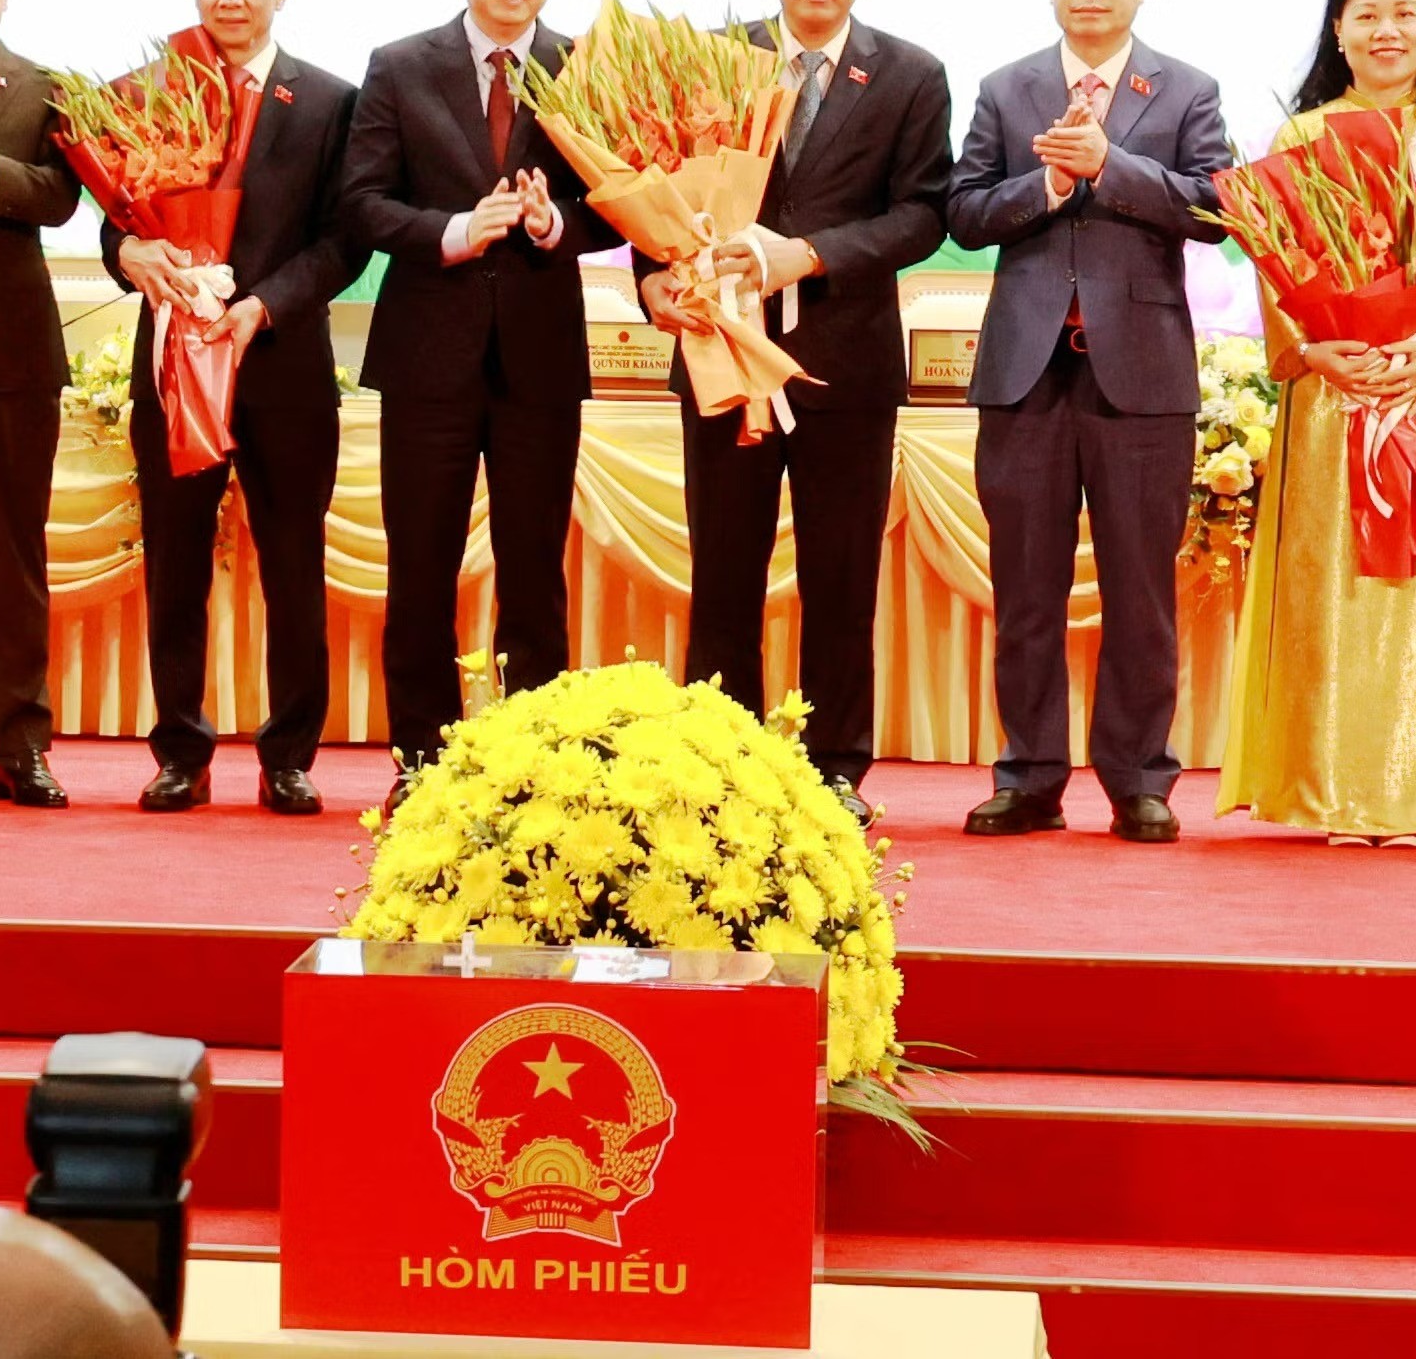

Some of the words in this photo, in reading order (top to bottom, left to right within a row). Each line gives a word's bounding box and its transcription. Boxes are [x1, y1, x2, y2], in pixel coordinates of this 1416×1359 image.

[592, 357, 631, 370] QUỲNH
[551, 1199, 583, 1214] NAM
[400, 1245, 516, 1290] HÒM
[534, 1248, 688, 1295] PHIẾU
